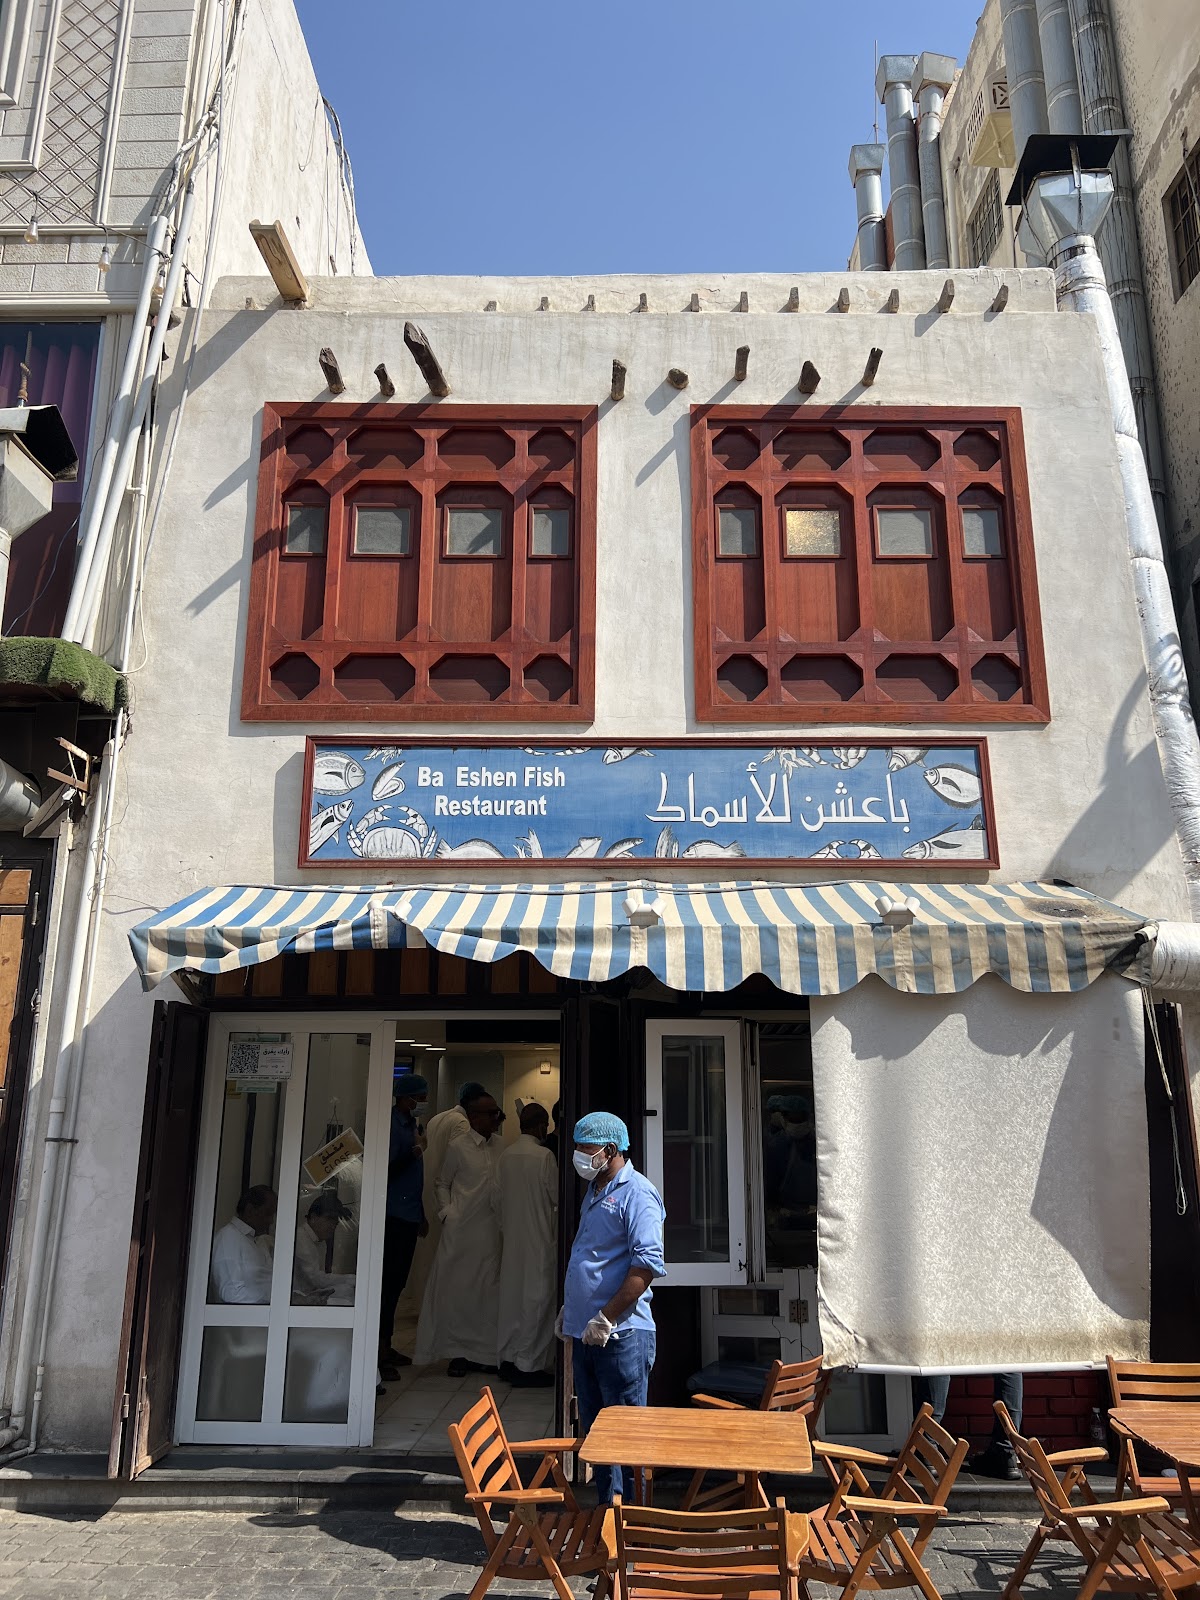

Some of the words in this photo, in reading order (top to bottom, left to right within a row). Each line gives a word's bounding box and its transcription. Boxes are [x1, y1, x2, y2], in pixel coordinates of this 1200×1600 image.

[417, 766, 444, 787] Ba
[456, 766, 517, 787] Eshen
[524, 766, 566, 787] Fish
[434, 794, 547, 816] Restaurant
[644, 761, 793, 829] للأسماك
[800, 772, 911, 834] باعشن
[318, 1142, 345, 1166] مغلق
